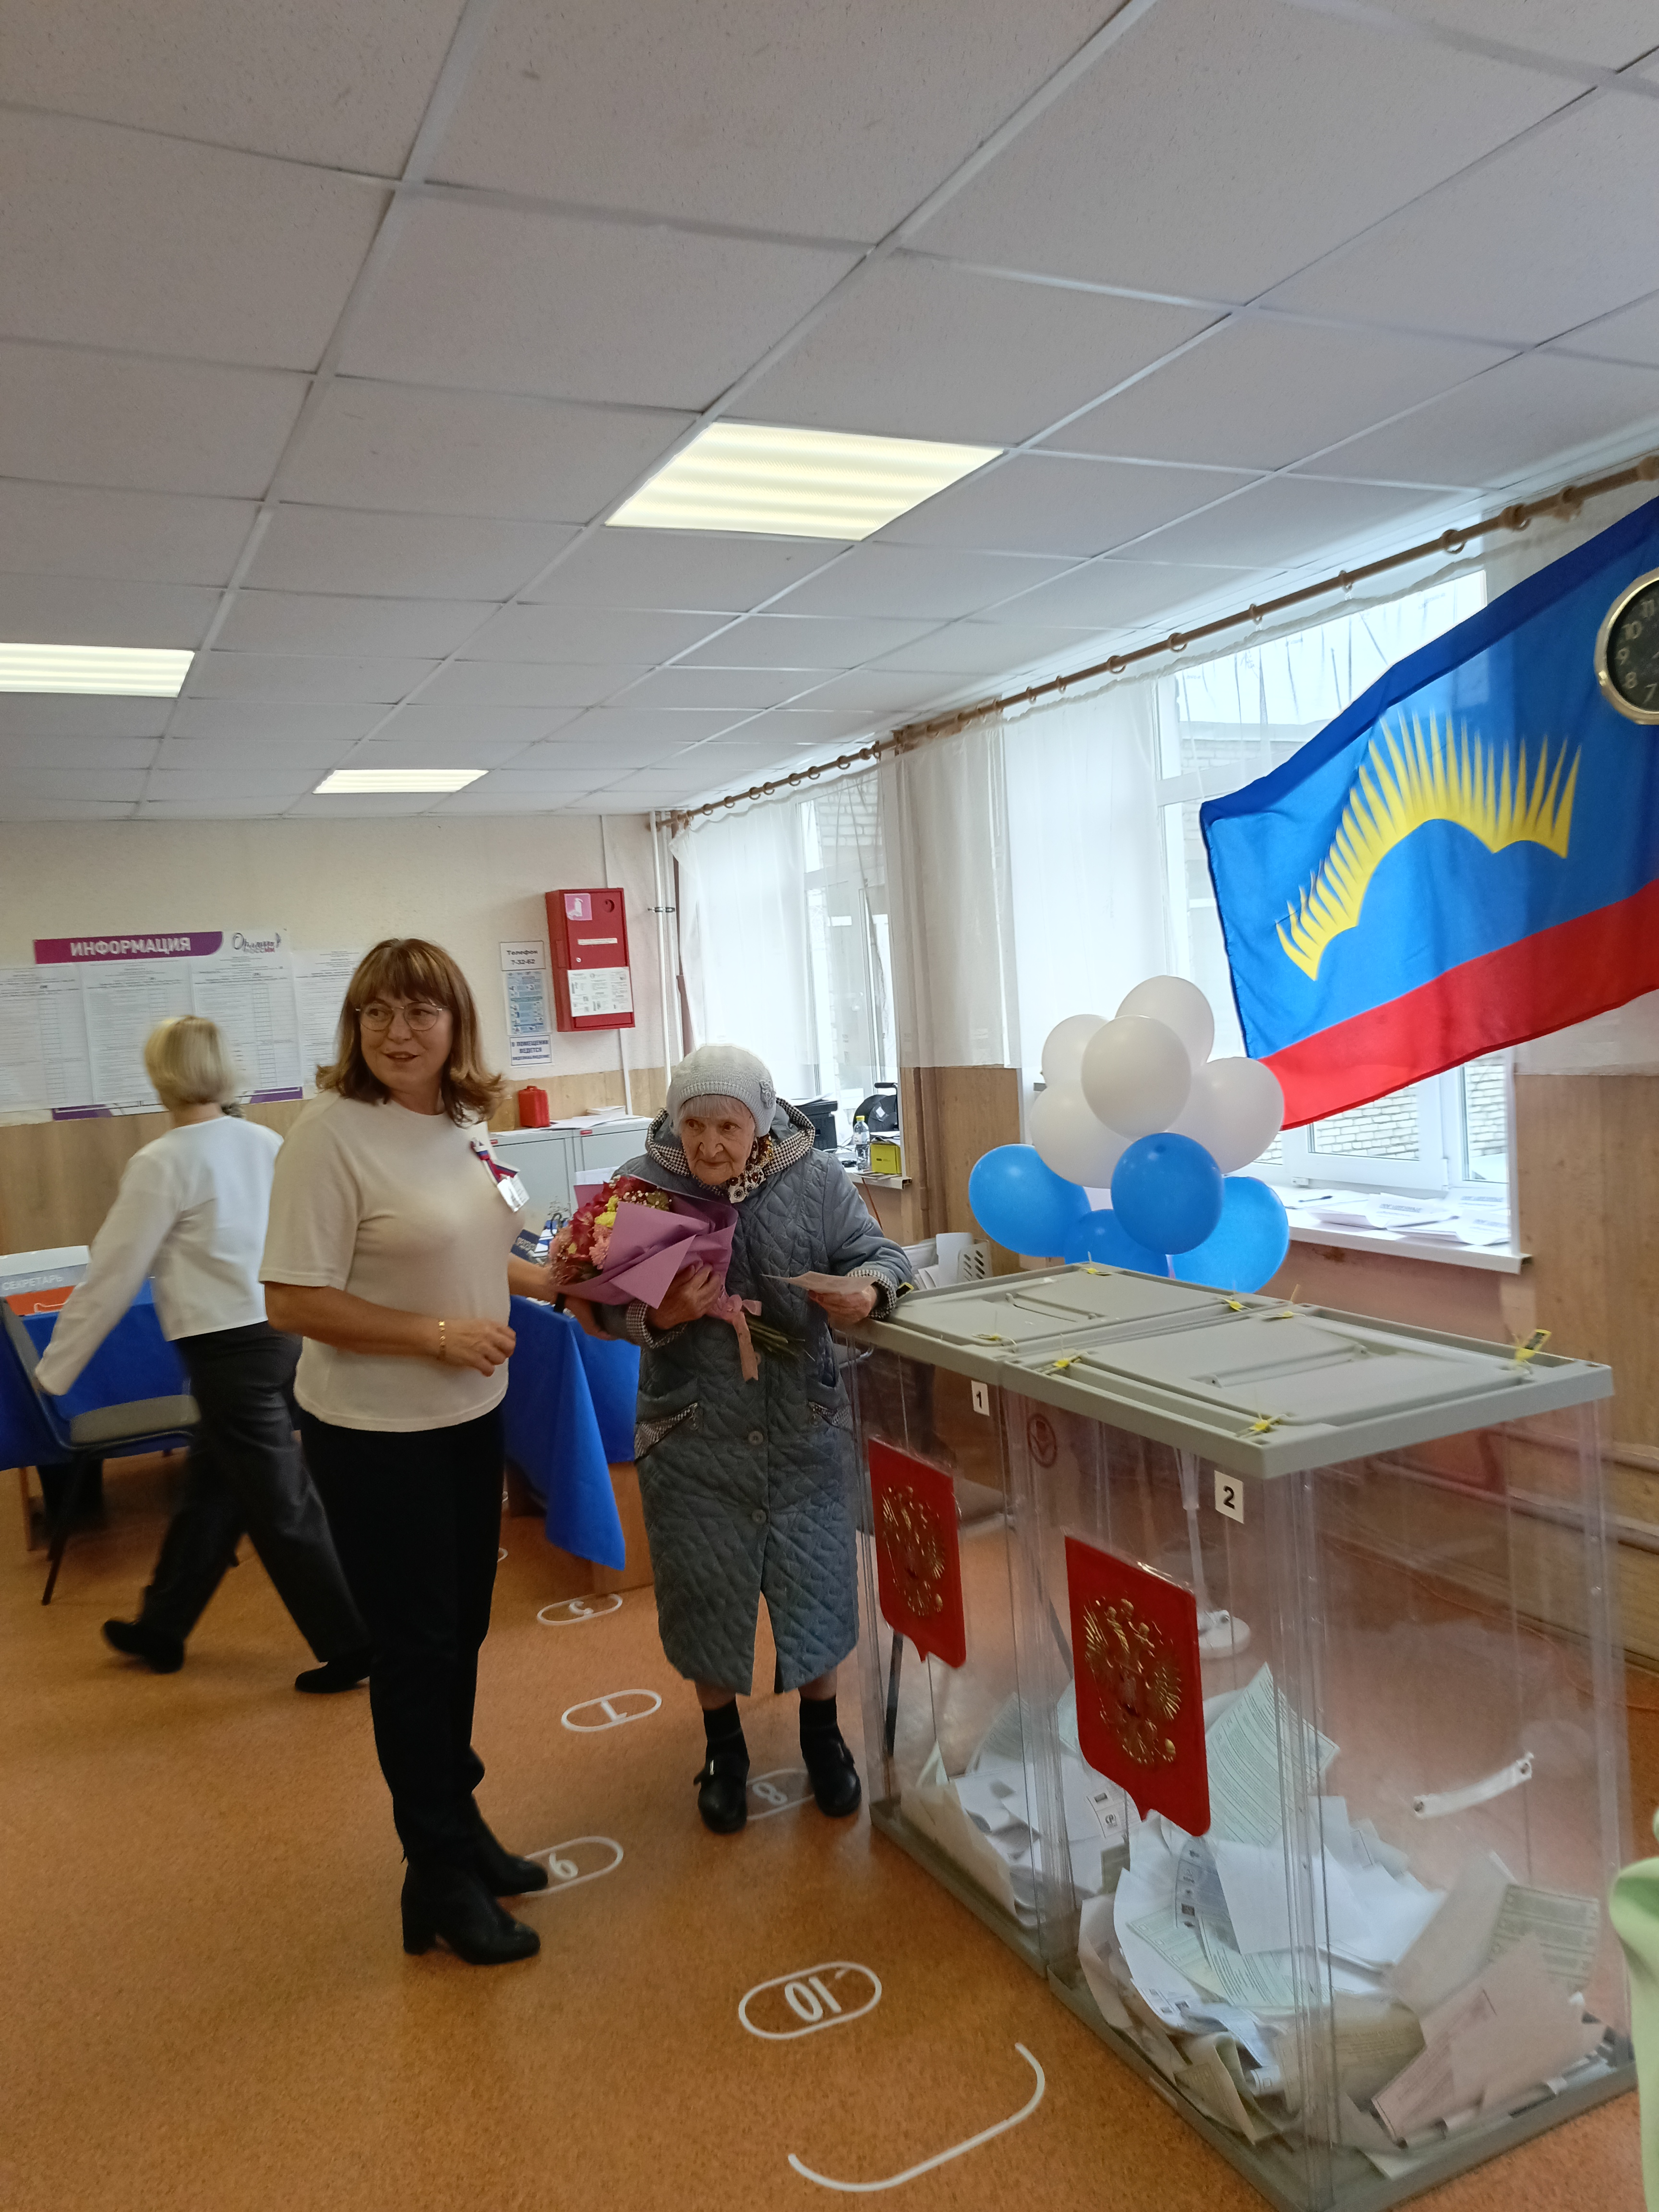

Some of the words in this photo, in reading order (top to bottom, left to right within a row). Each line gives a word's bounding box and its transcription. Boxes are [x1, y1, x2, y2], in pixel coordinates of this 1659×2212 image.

[1622, 620, 1643, 640] 10
[1614, 647, 1631, 666] 9
[1623, 671, 1638, 689] 8
[1643, 683, 1658, 705] 7
[70, 938, 191, 957] ИНФОРМАЦИЯ
[2, 1274, 64, 1290] СЕКРЕТАРЬ
[976, 1390, 982, 1409] 1
[1223, 1485, 1236, 1510] 2
[752, 1782, 787, 1805] 8
